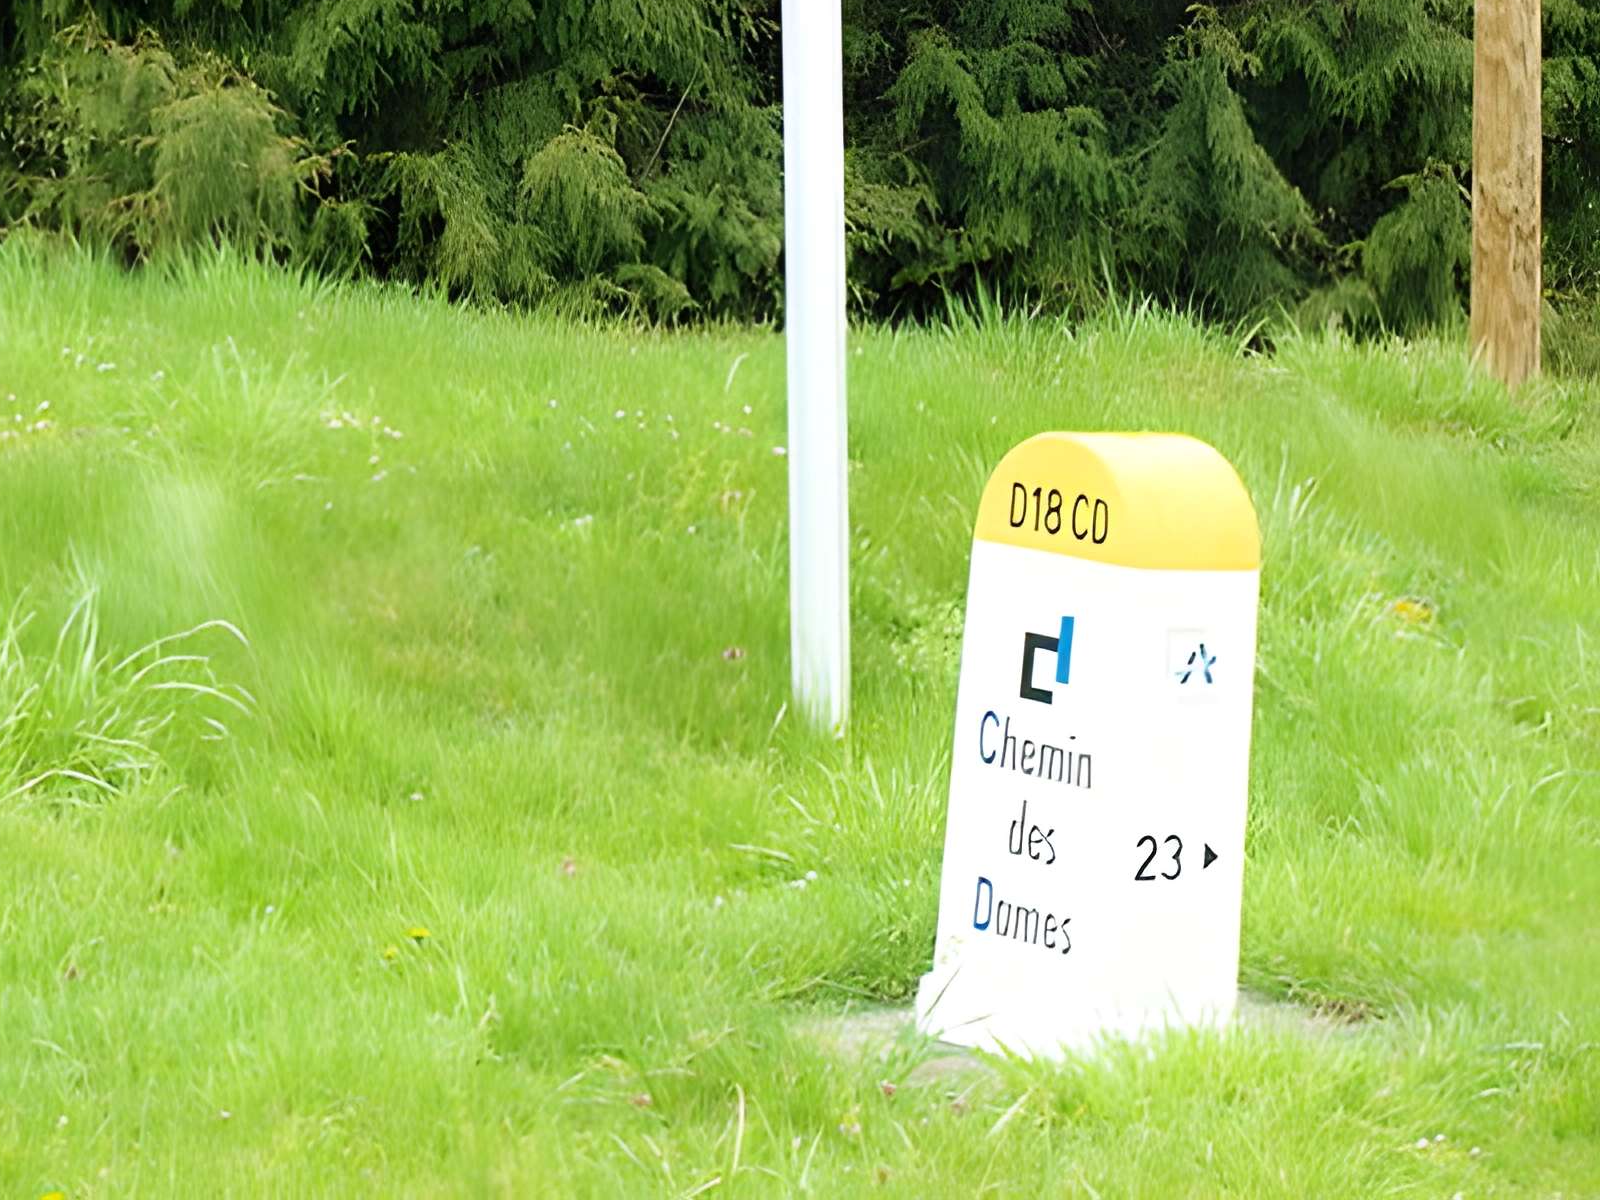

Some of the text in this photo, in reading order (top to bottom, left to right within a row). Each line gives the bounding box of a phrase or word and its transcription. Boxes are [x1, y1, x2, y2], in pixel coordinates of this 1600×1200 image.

[978, 710, 1092, 789] Chemin
[1008, 799, 1056, 866] des
[1134, 834, 1184, 882] 23
